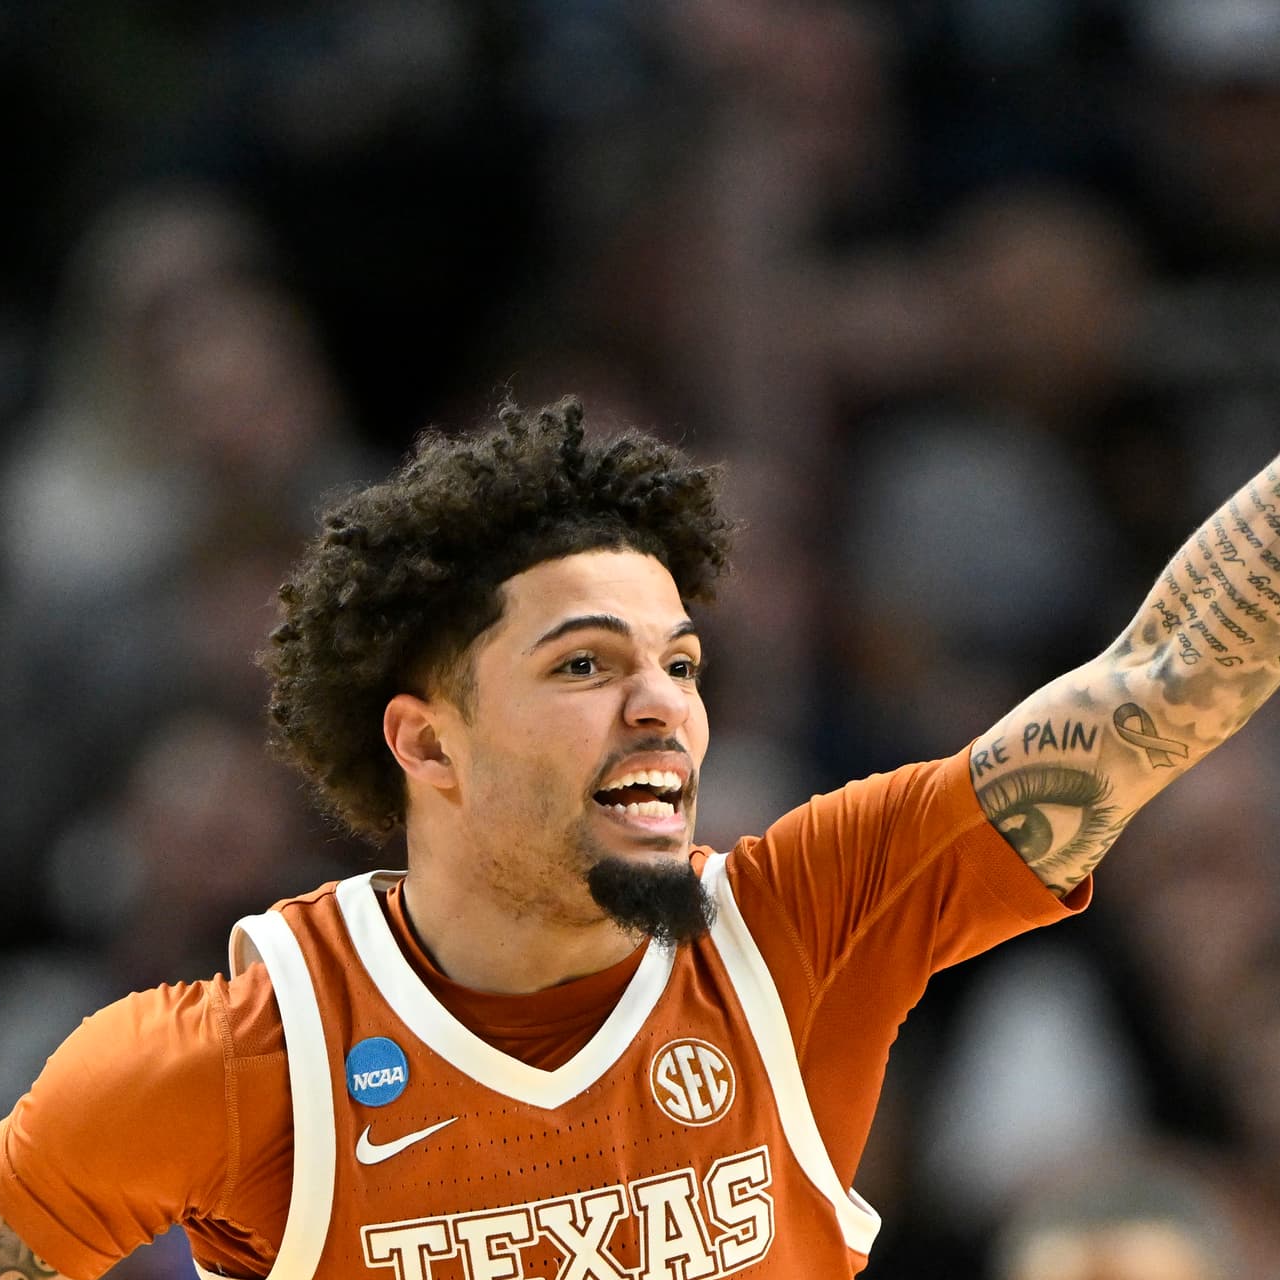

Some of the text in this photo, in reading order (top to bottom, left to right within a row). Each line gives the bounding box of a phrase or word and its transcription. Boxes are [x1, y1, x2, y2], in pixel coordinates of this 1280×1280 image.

[1148, 597, 1183, 635] Lord
[1177, 590, 1199, 621] here
[1174, 631, 1202, 664] Dear
[1021, 717, 1098, 754] PAIN
[352, 1064, 405, 1092] NCAA
[663, 1046, 729, 1121] SEC
